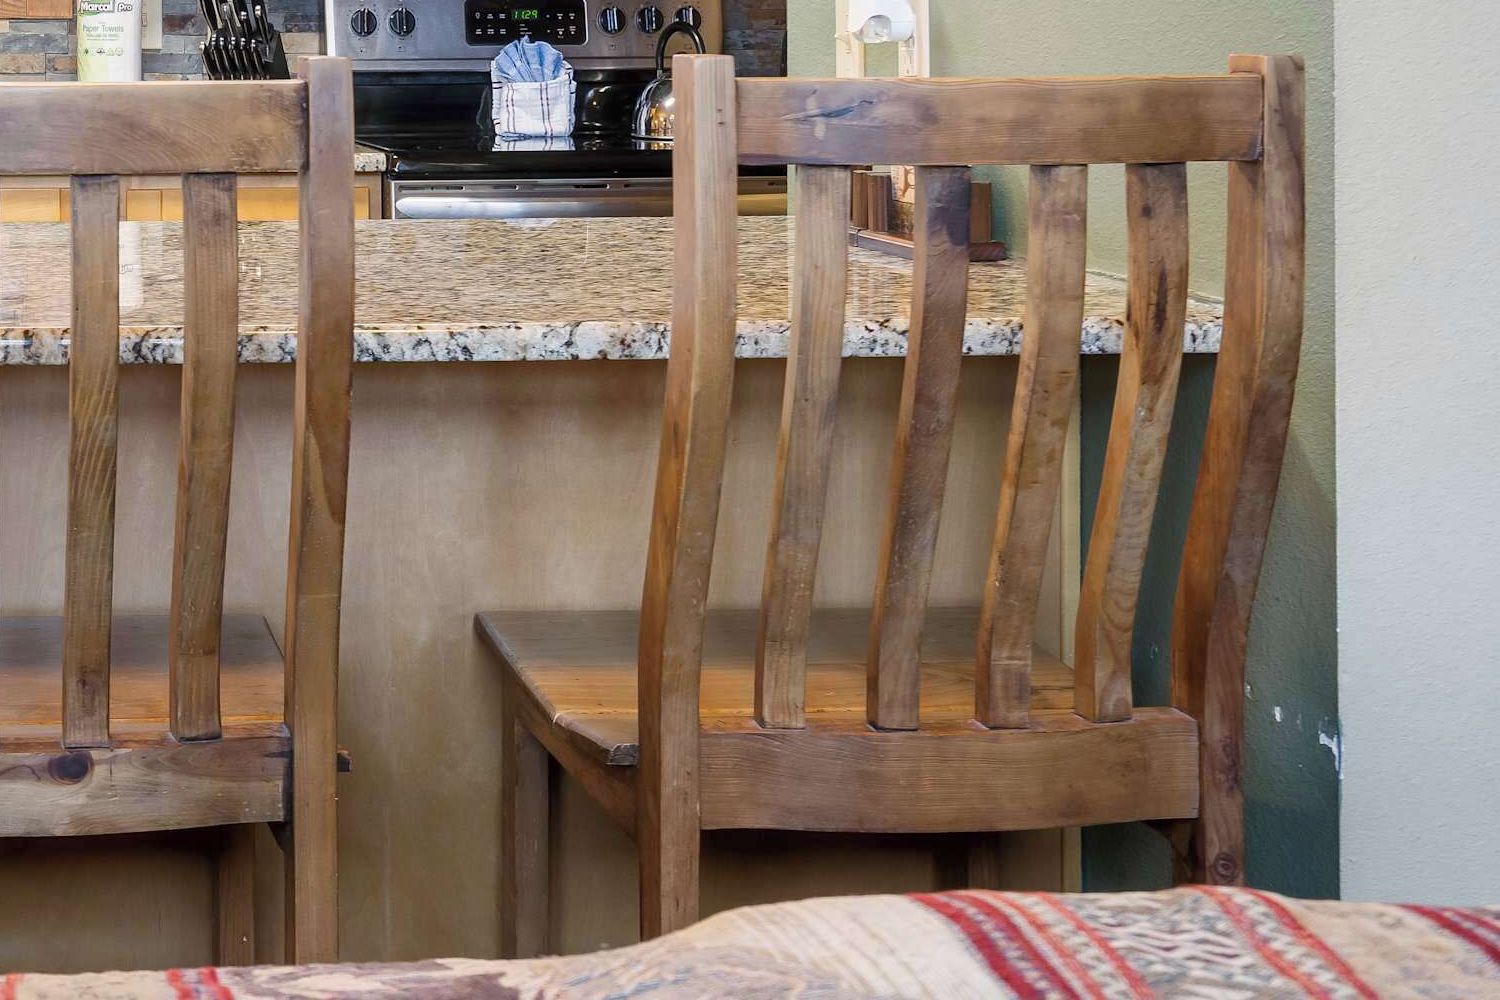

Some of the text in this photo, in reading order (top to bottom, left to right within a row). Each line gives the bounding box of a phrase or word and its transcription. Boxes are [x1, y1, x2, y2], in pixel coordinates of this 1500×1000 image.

[117, 2, 132, 12] Pro
[83, 24, 125, 33] Paper Towels
